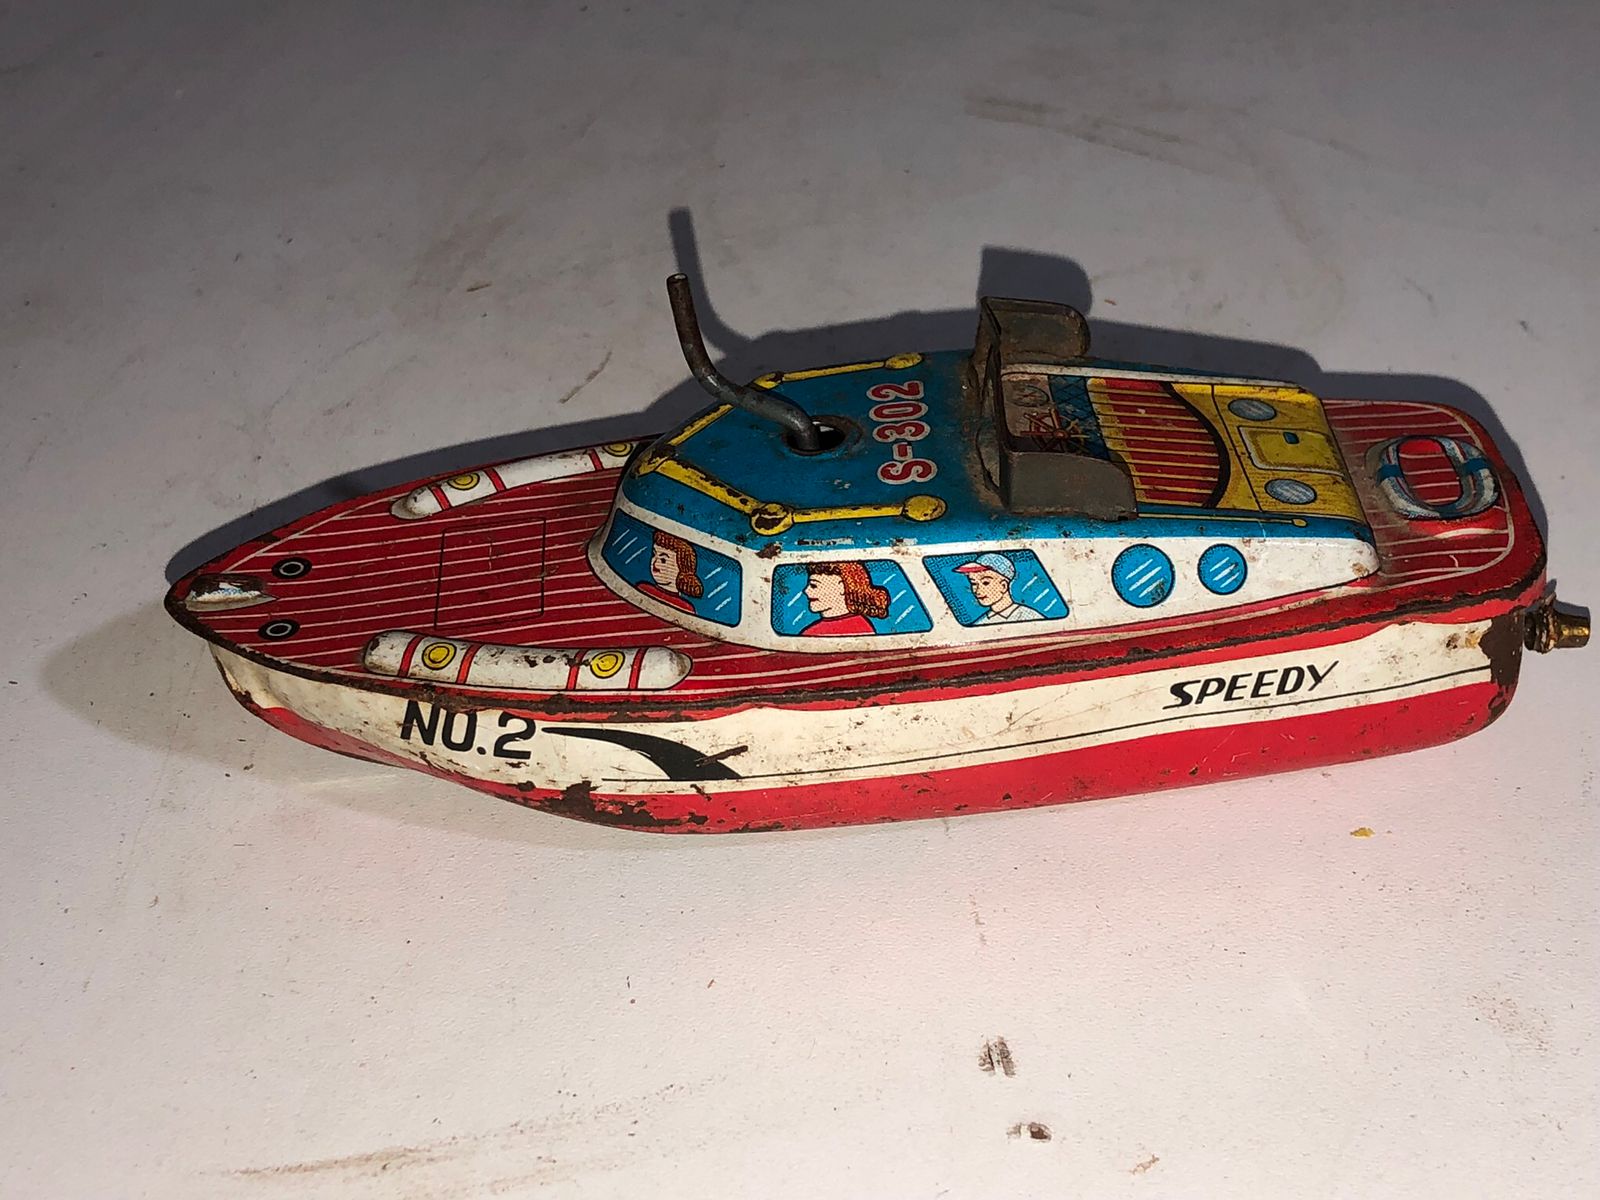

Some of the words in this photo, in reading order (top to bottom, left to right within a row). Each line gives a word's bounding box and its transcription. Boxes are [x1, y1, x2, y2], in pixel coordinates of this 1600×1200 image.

[866, 380, 938, 485] S-302
[1162, 660, 1340, 710] SPEEDY
[400, 699, 537, 760] NO.2
